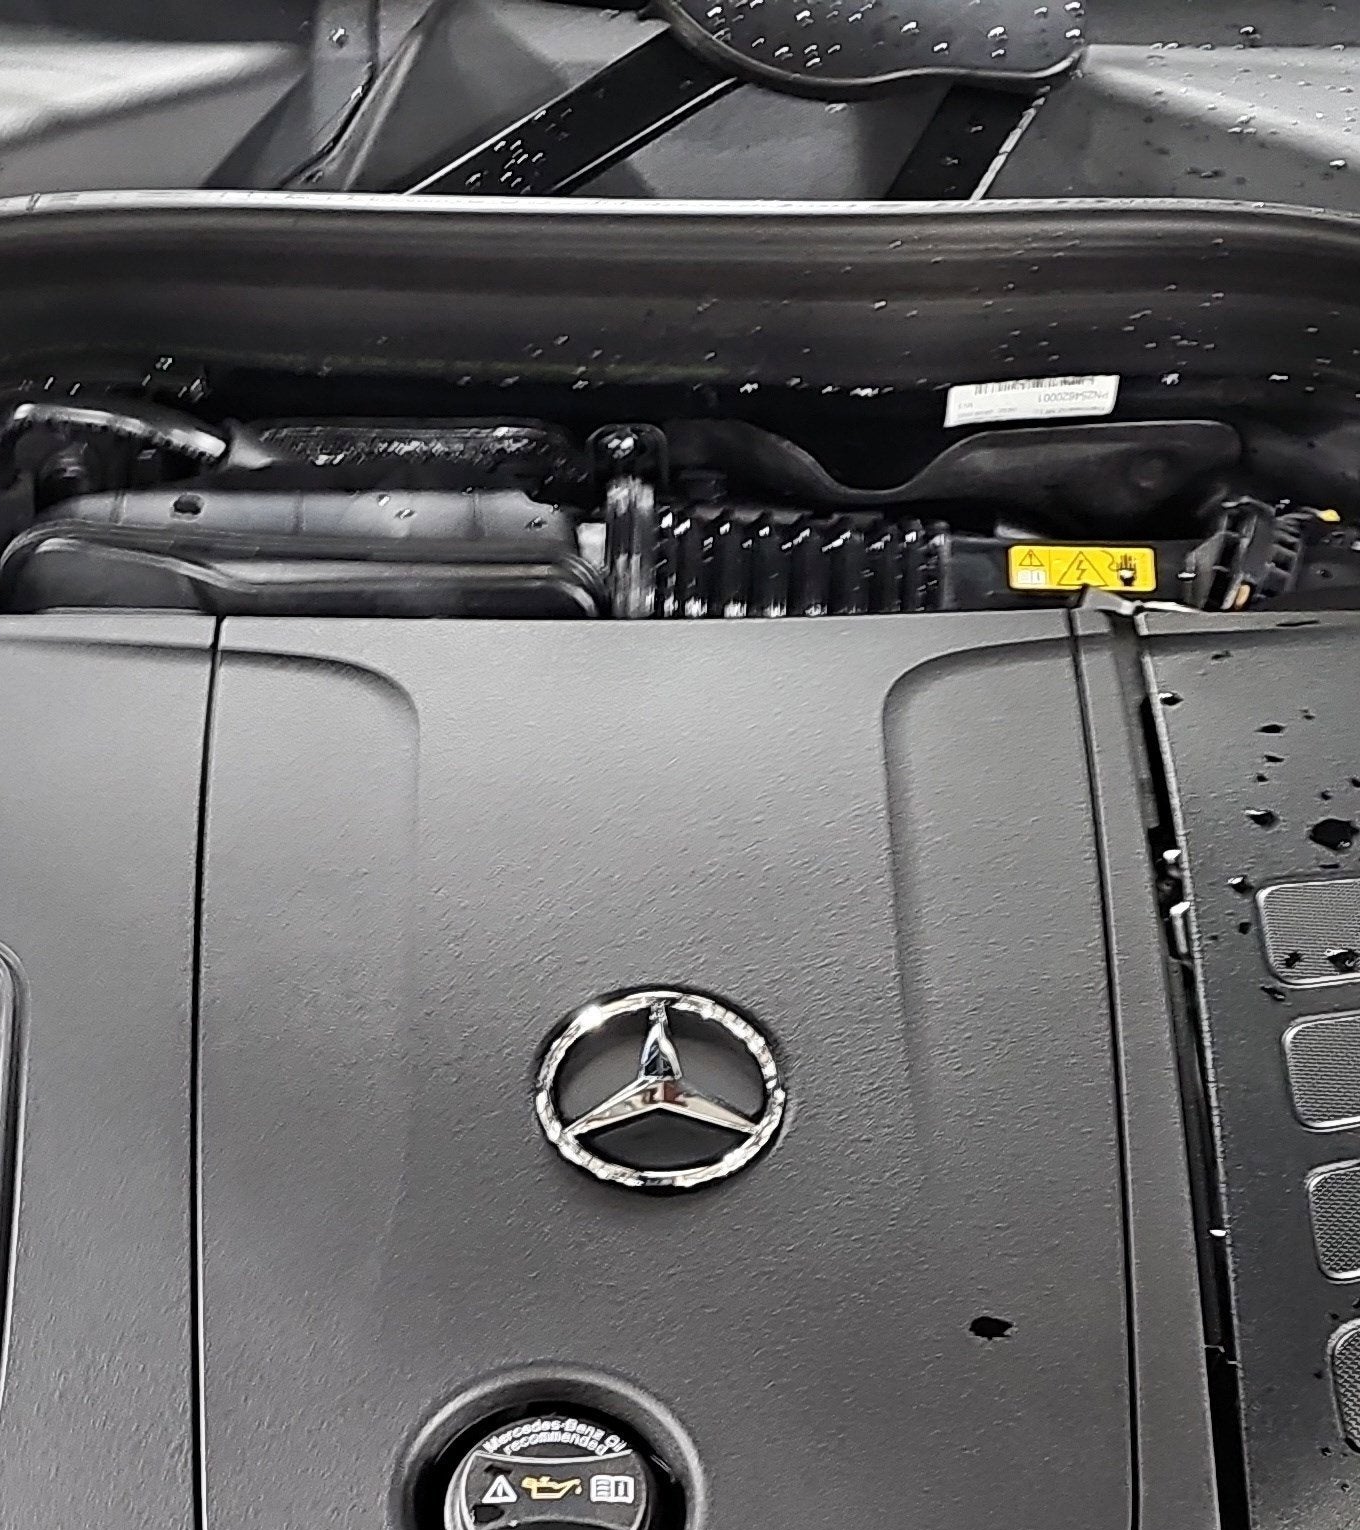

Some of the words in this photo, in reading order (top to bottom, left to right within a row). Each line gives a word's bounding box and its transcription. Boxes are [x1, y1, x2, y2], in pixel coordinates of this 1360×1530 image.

[482, 1418, 606, 1454] Mercedes-Benz
[604, 1434, 628, 1453] Oil
[503, 1431, 609, 1456] recommended
